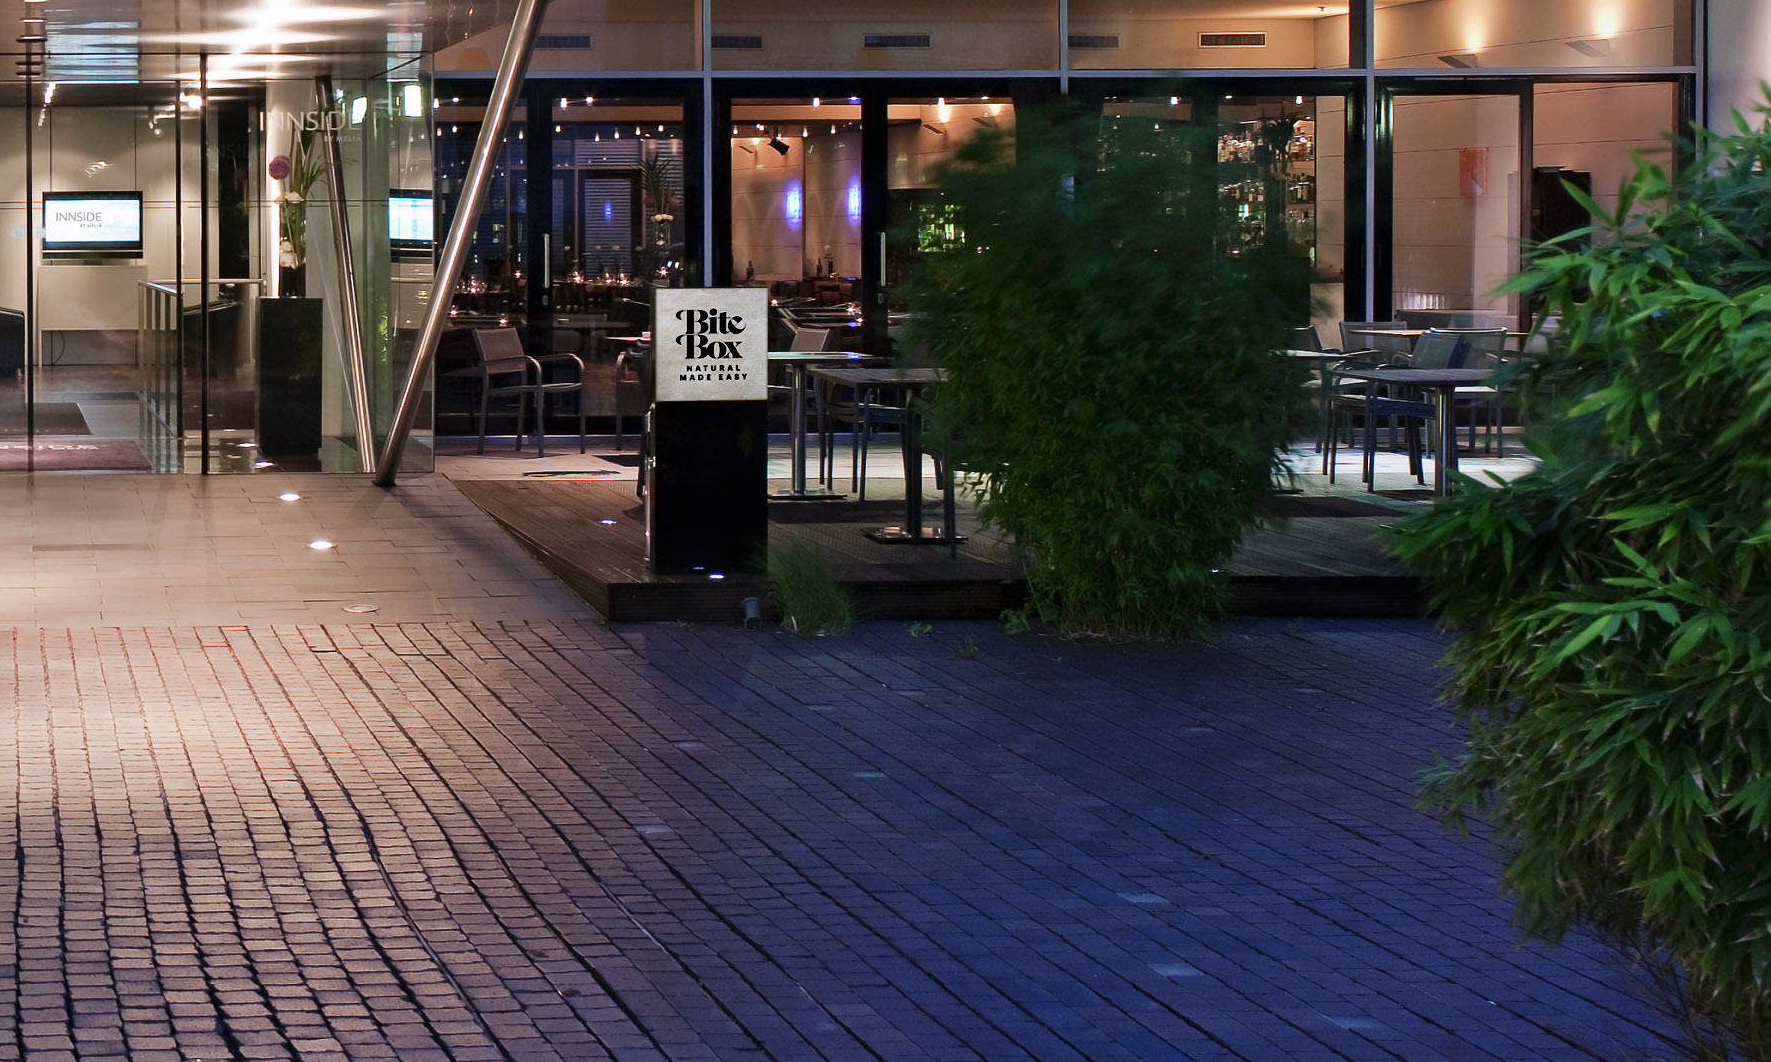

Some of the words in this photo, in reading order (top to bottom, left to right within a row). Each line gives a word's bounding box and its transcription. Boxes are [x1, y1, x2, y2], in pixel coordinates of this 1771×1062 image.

[55, 212, 102, 222] INNSIDE
[675, 308, 747, 335] Bite
[675, 334, 744, 360] Box
[686, 364, 741, 372] NATURAL
[679, 373, 712, 381] MADE
[718, 373, 748, 381] EASY
